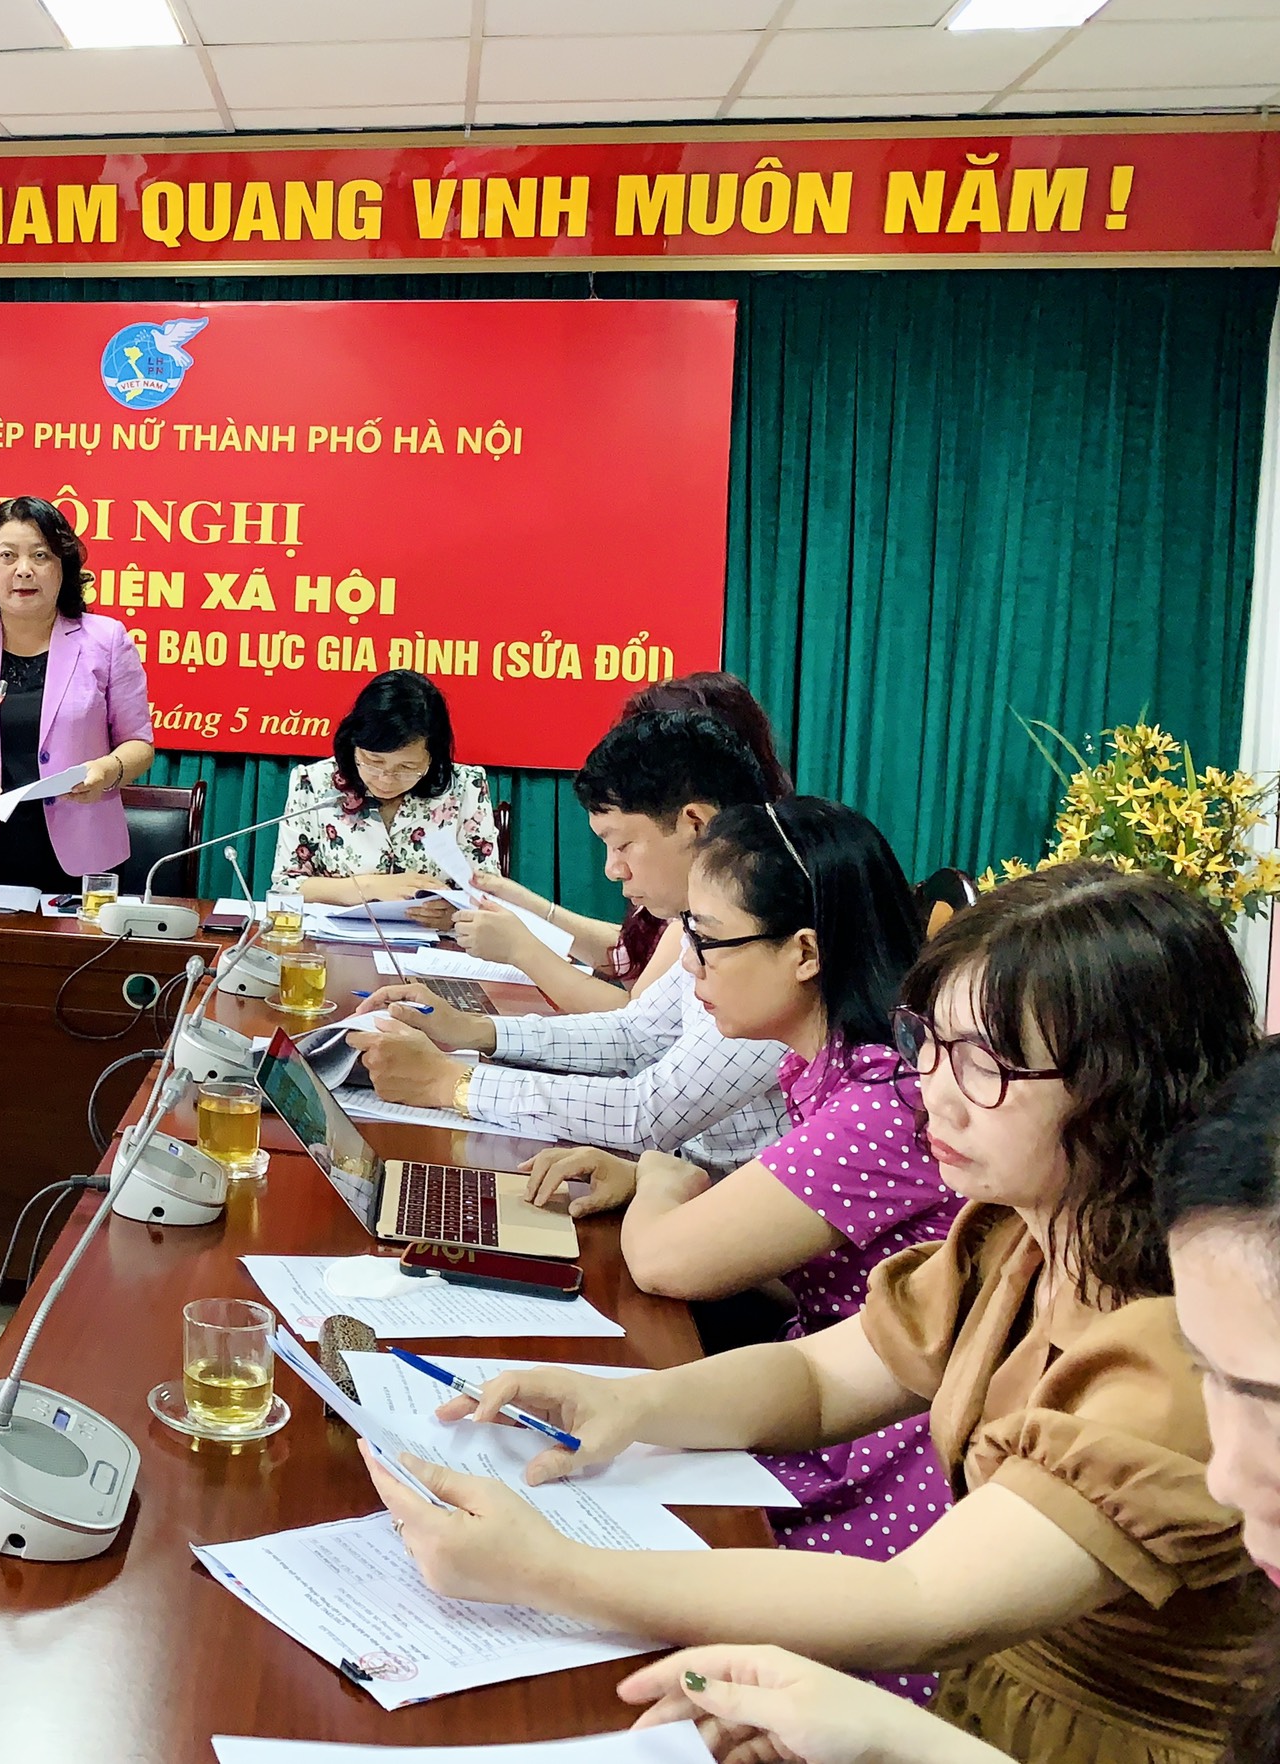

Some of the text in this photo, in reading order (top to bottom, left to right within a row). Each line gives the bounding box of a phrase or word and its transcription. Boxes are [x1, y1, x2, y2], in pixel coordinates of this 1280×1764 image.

[142, 178, 382, 247] QUANG
[413, 176, 589, 238] VINH
[616, 158, 852, 236] MUÔN
[884, 152, 1087, 233] NĂM
[142, 380, 164, 391] NAM
[34, 422, 101, 456] PHỤ
[112, 417, 166, 451] NỮ
[173, 417, 296, 453] THÀNH
[307, 417, 383, 454] PHỐ
[393, 419, 445, 454] HÀ
[456, 421, 523, 461] NỘI
[131, 499, 306, 558] NGHỊ
[200, 566, 277, 612] XÃ
[294, 569, 397, 625] HỘI
[158, 629, 228, 673] BẠO
[238, 630, 306, 676] LỰC
[317, 635, 377, 672] GIA
[388, 630, 479, 676] ĐÌNH
[492, 630, 583, 681] (SỬA
[594, 630, 674, 684] ĐỔI)
[147, 702, 222, 736] háng
[229, 706, 250, 733] 5
[259, 708, 331, 736] năm
